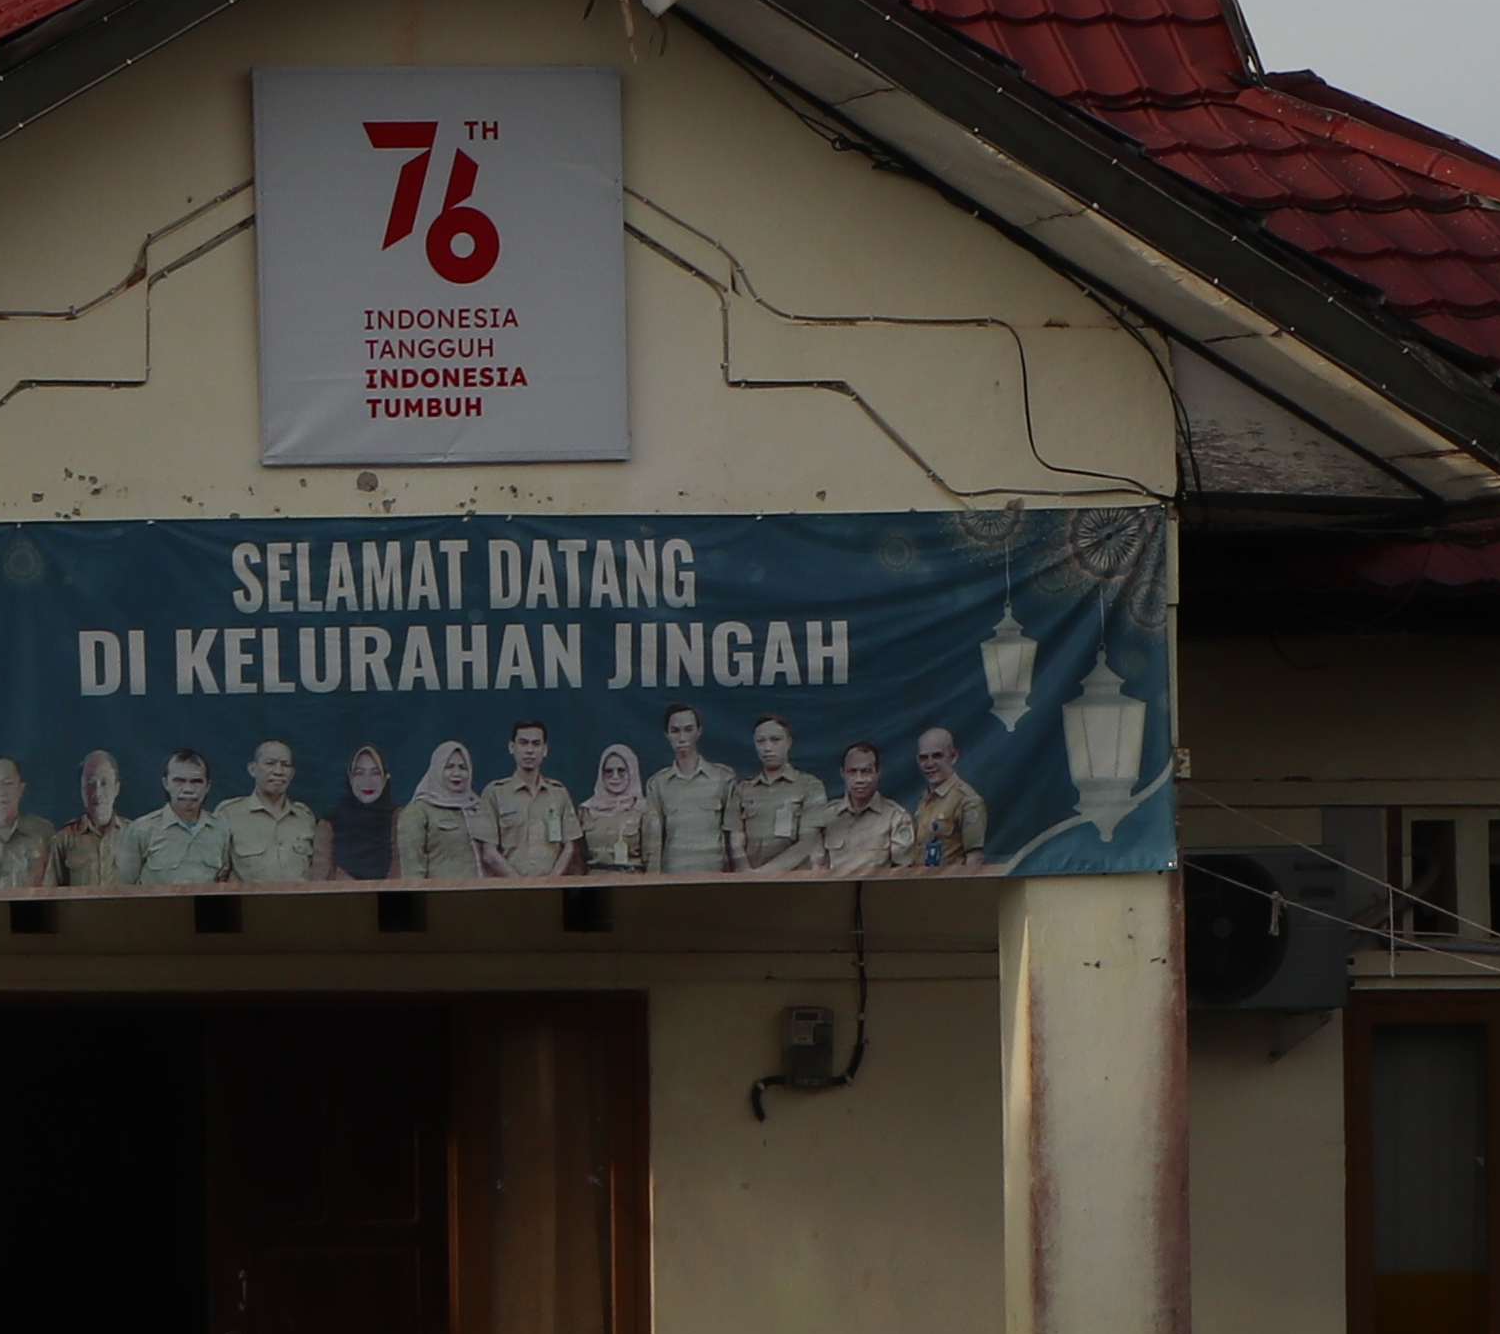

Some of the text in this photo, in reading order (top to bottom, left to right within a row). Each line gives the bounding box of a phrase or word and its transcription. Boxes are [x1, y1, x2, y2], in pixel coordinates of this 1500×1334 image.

[364, 308, 519, 330] INDONESIA
[365, 338, 494, 359] TANGGUH
[366, 367, 528, 388] INDONESIA
[366, 397, 482, 418] TUMBUH
[231, 537, 697, 614] SELAMAT DATANG
[78, 619, 850, 697] DI KELURAHAN JINGAH
